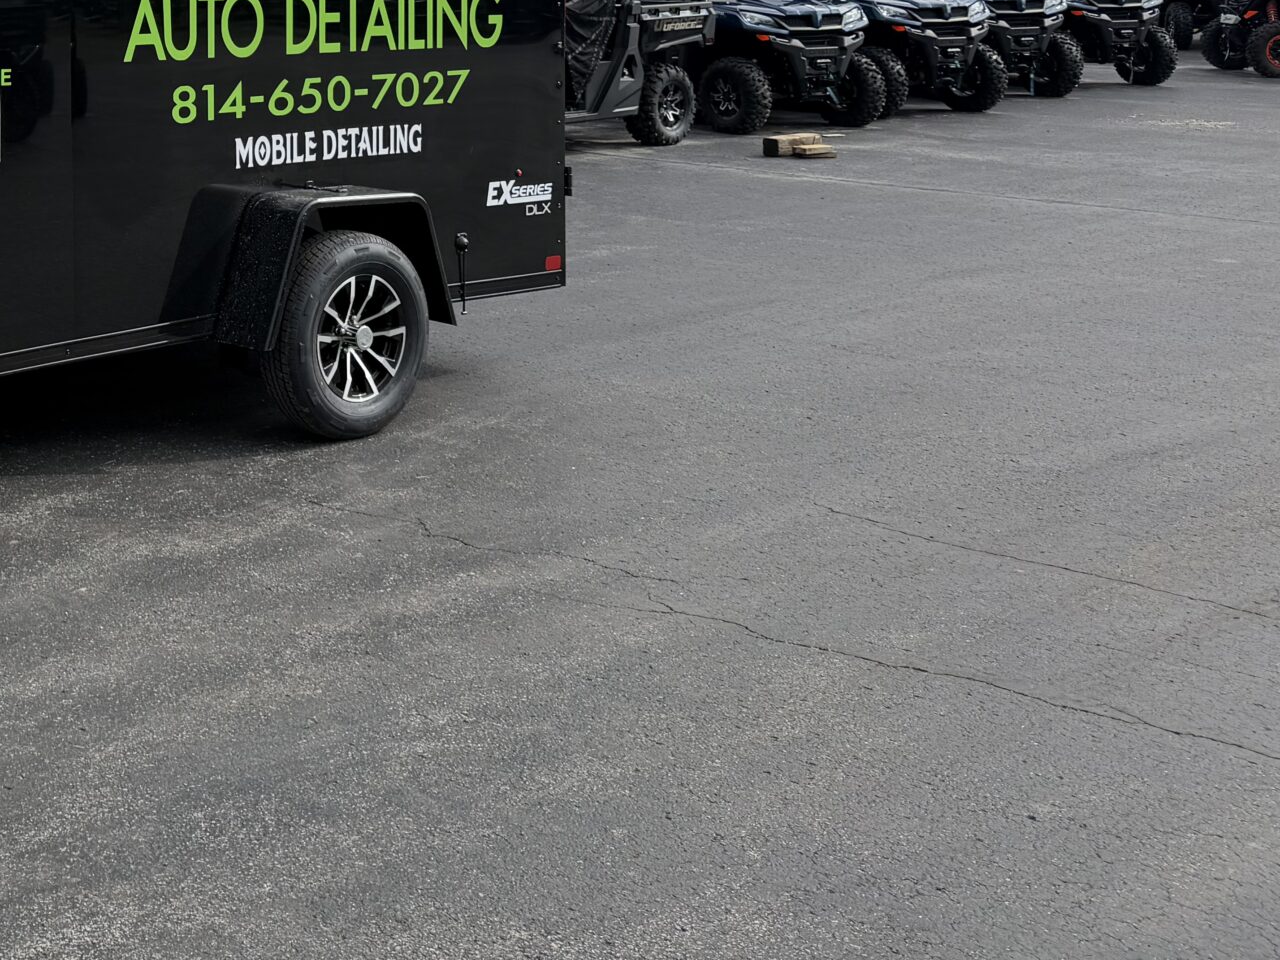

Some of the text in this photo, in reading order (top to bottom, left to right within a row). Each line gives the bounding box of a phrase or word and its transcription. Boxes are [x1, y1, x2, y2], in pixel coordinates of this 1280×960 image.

[172, 69, 470, 124] 814-650-7027
[235, 123, 422, 170] MOBILE DETAILING
[526, 202, 551, 216] DLX
